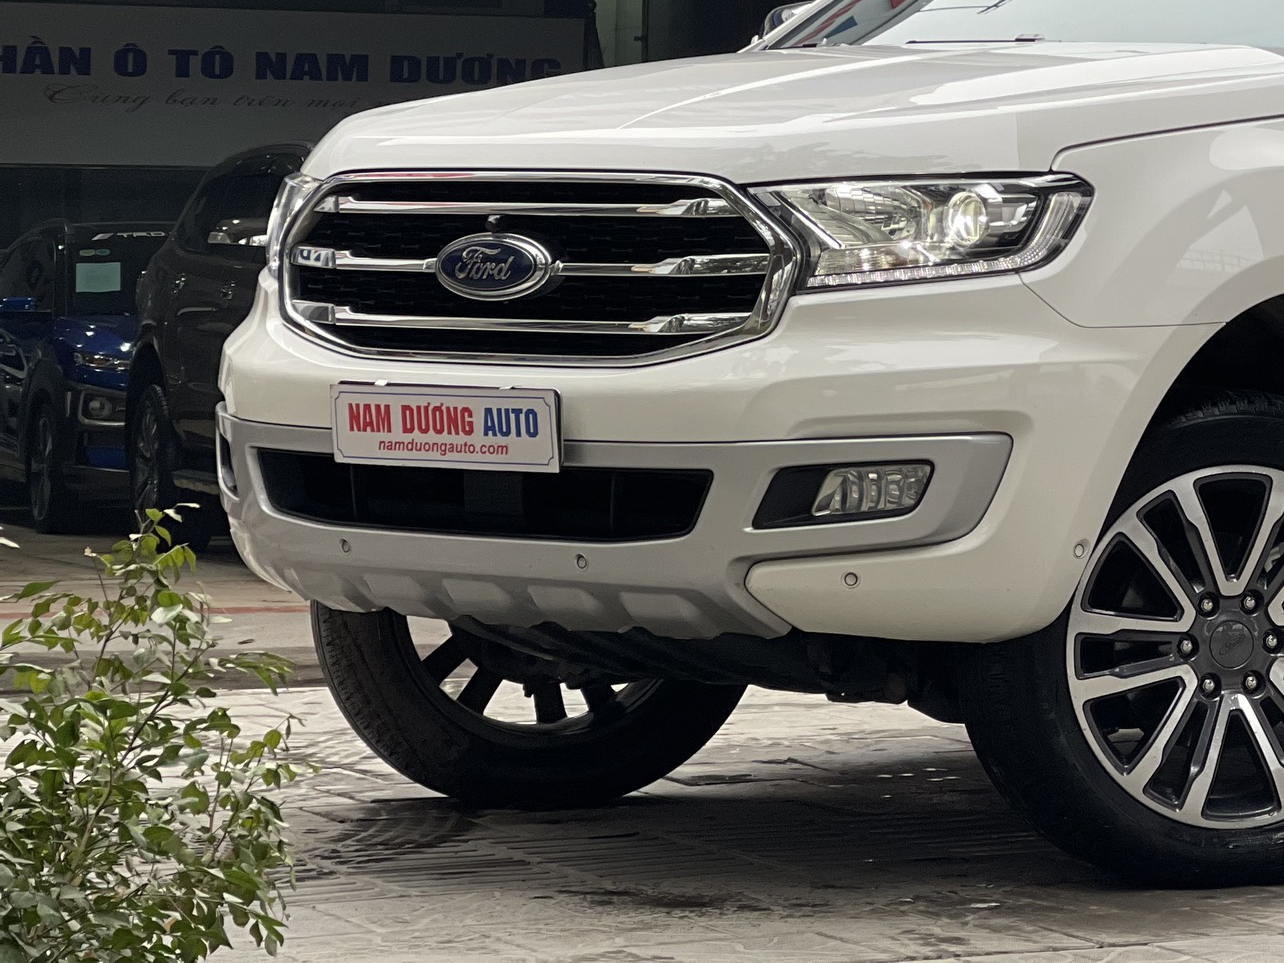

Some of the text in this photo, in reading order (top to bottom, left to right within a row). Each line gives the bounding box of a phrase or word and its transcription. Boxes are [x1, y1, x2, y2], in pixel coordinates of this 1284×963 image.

[113, 42, 148, 77] Ô
[167, 44, 235, 80] TÔ
[254, 51, 369, 83] NAM
[454, 246, 515, 280] Ford
[347, 401, 540, 438] NAM DƯƠNG AUTO
[378, 438, 510, 457] namduongauto.com
